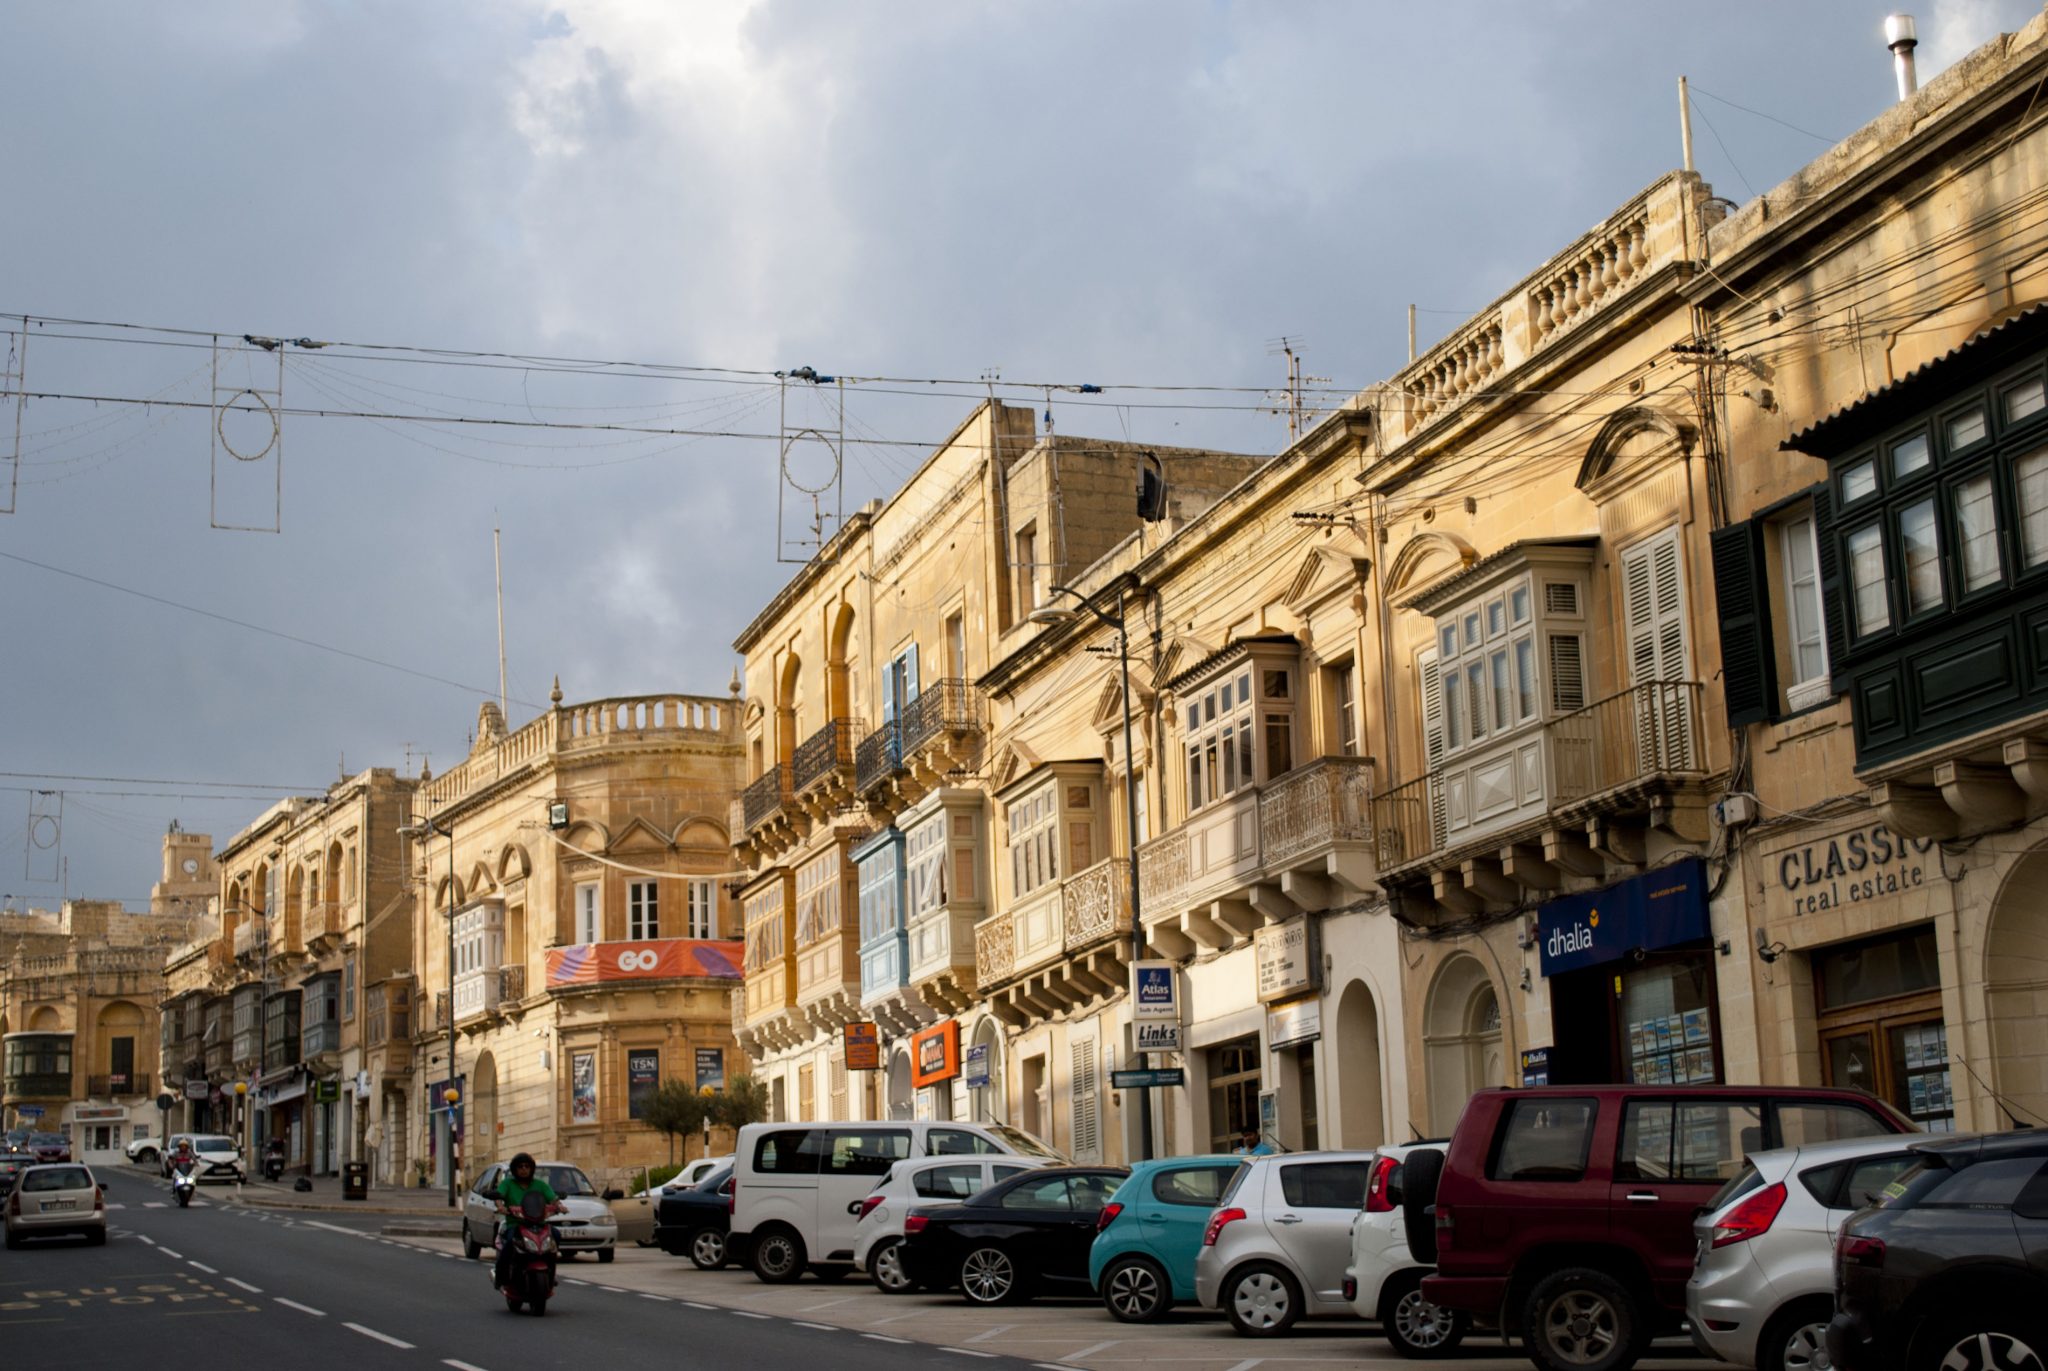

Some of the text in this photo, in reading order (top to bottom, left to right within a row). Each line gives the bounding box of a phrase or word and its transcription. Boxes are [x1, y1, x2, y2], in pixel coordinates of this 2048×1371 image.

[1795, 865, 1923, 916] real estate
[1548, 922, 1593, 957] dhalia
[618, 949, 658, 971] GO
[1141, 984, 1169, 995] Atlas
[1139, 1024, 1177, 1041] Links
[632, 1059, 655, 1069] TSN
[847, 1200, 864, 1215] G
[22, 1284, 177, 1299] BUS
[0, 1293, 209, 1311] STOP
